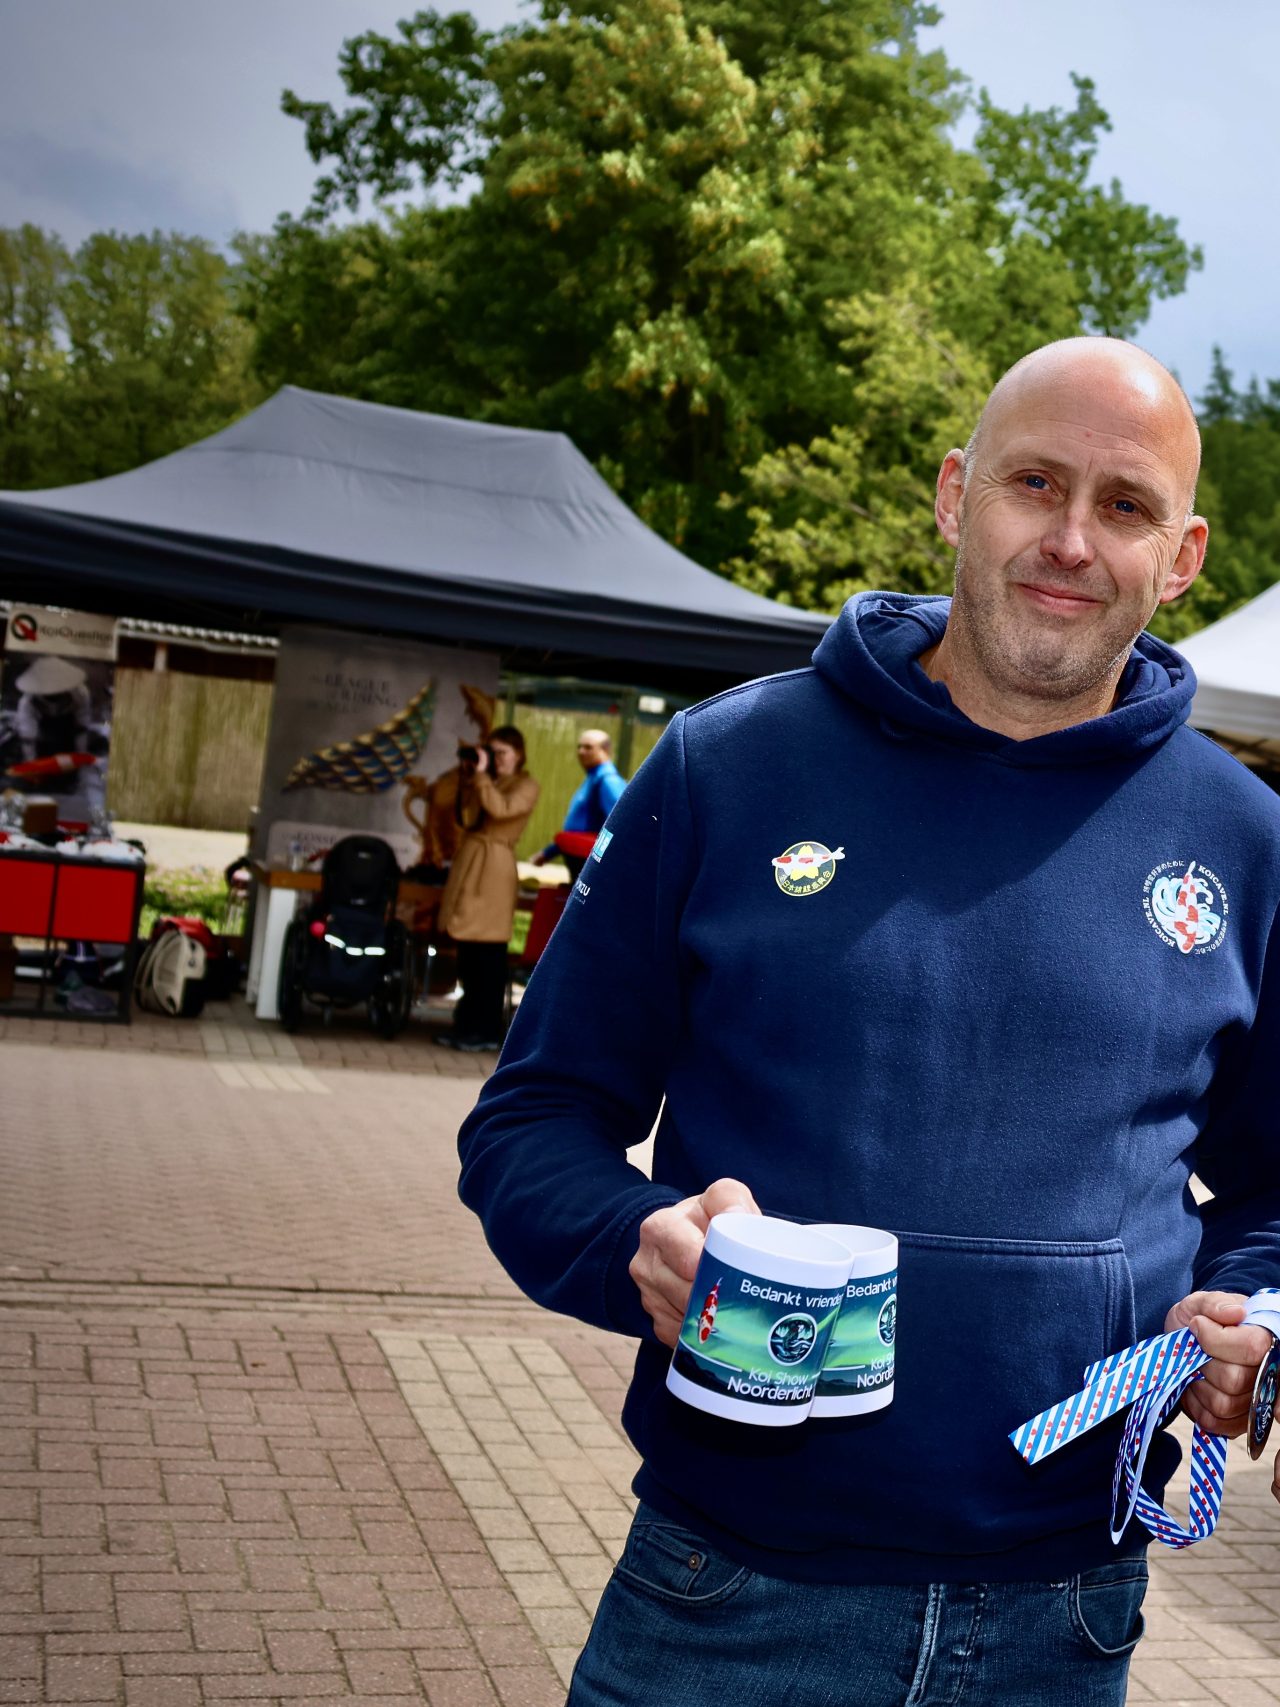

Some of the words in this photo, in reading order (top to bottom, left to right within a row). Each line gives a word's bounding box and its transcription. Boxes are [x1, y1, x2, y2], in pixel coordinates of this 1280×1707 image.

[1198, 865, 1229, 916] KOICAVE.NL
[1142, 896, 1176, 948] KOICAVE.NL
[740, 1279, 801, 1307] Bedankt
[846, 1280, 891, 1298] Bedankt
[727, 1376, 813, 1401] Noorderlicht
[749, 1367, 773, 1384] Koi
[774, 1371, 808, 1386] Show
